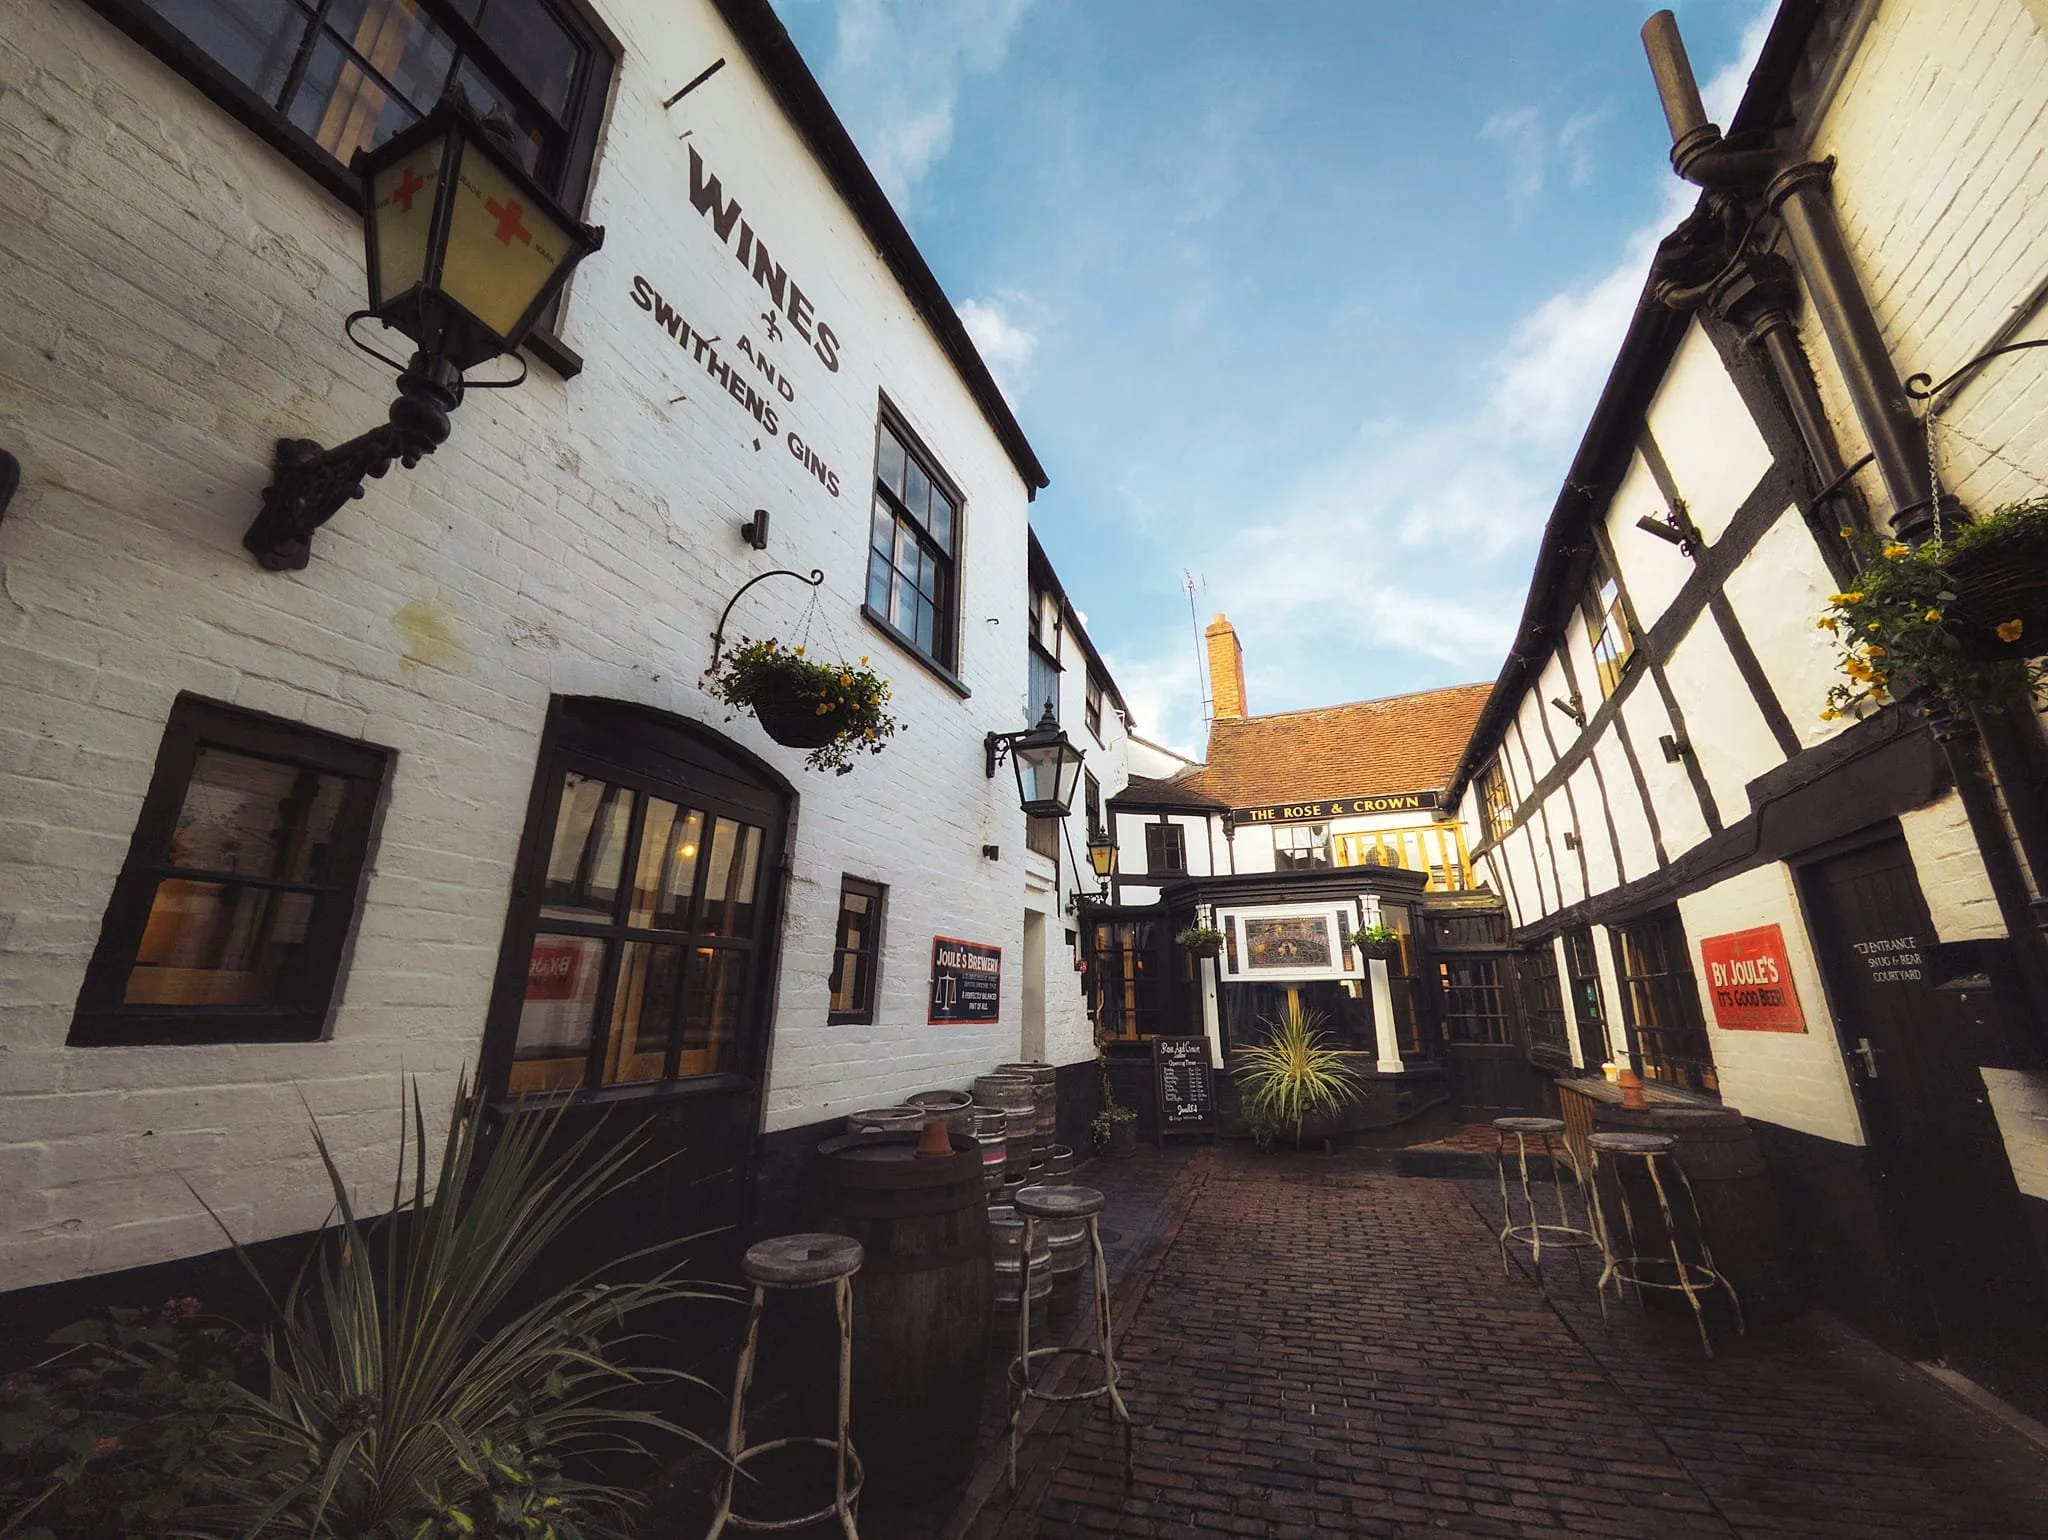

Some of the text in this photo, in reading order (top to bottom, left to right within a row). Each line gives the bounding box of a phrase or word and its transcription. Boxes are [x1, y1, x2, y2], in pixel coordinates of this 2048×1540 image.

[688, 143, 839, 373] WINES
[736, 334, 795, 402] AND
[787, 431, 840, 498] GINS
[1249, 796, 1419, 821] THE ROSE & CROWN
[1869, 936, 1916, 953] ENTRANCE
[937, 946, 999, 973] JOULE'S BREWERY
[1711, 955, 1779, 987] BY JOULE'S
[1867, 956, 1891, 968] SNUG
[1899, 953, 1922, 966] REAR
[1872, 969, 1922, 982] COURTYARD
[1734, 989, 1759, 1007] GOOD
